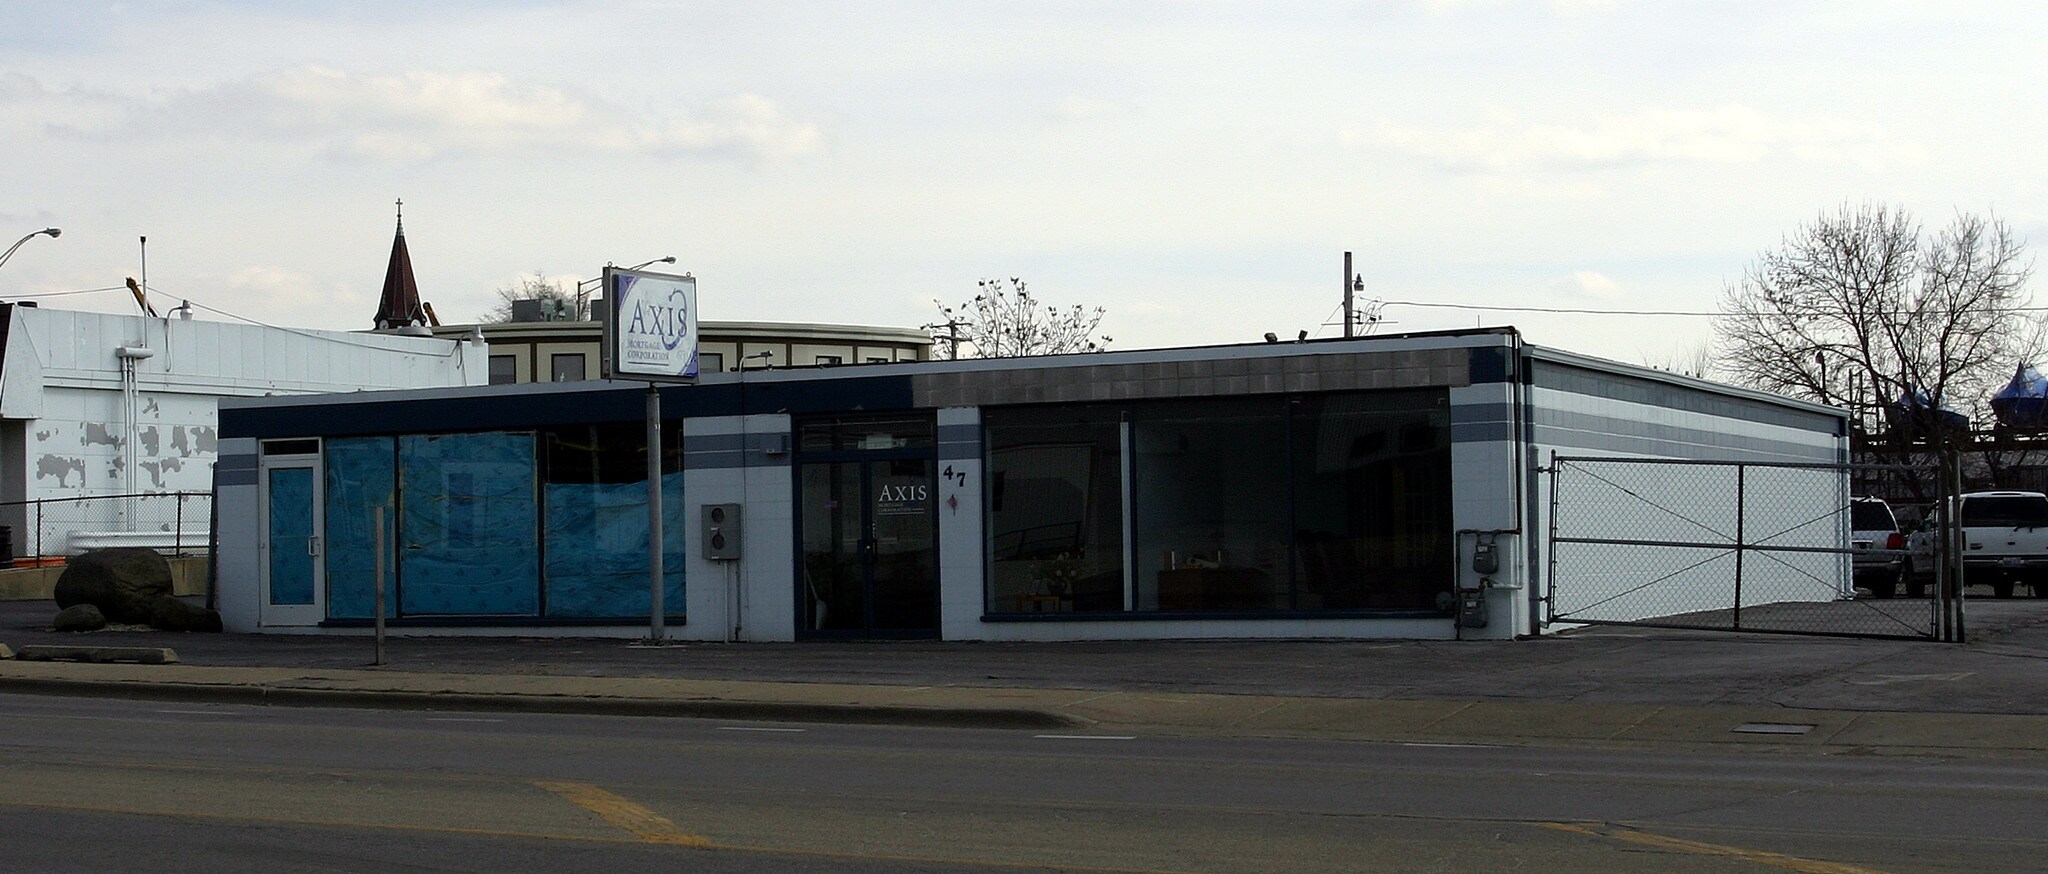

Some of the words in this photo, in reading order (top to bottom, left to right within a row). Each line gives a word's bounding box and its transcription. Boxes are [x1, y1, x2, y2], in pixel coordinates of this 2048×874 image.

[629, 298, 687, 337] AXIS
[628, 350, 669, 360] CORPORATION
[943, 464, 966, 487] 47
[878, 484, 927, 501] AXIS
